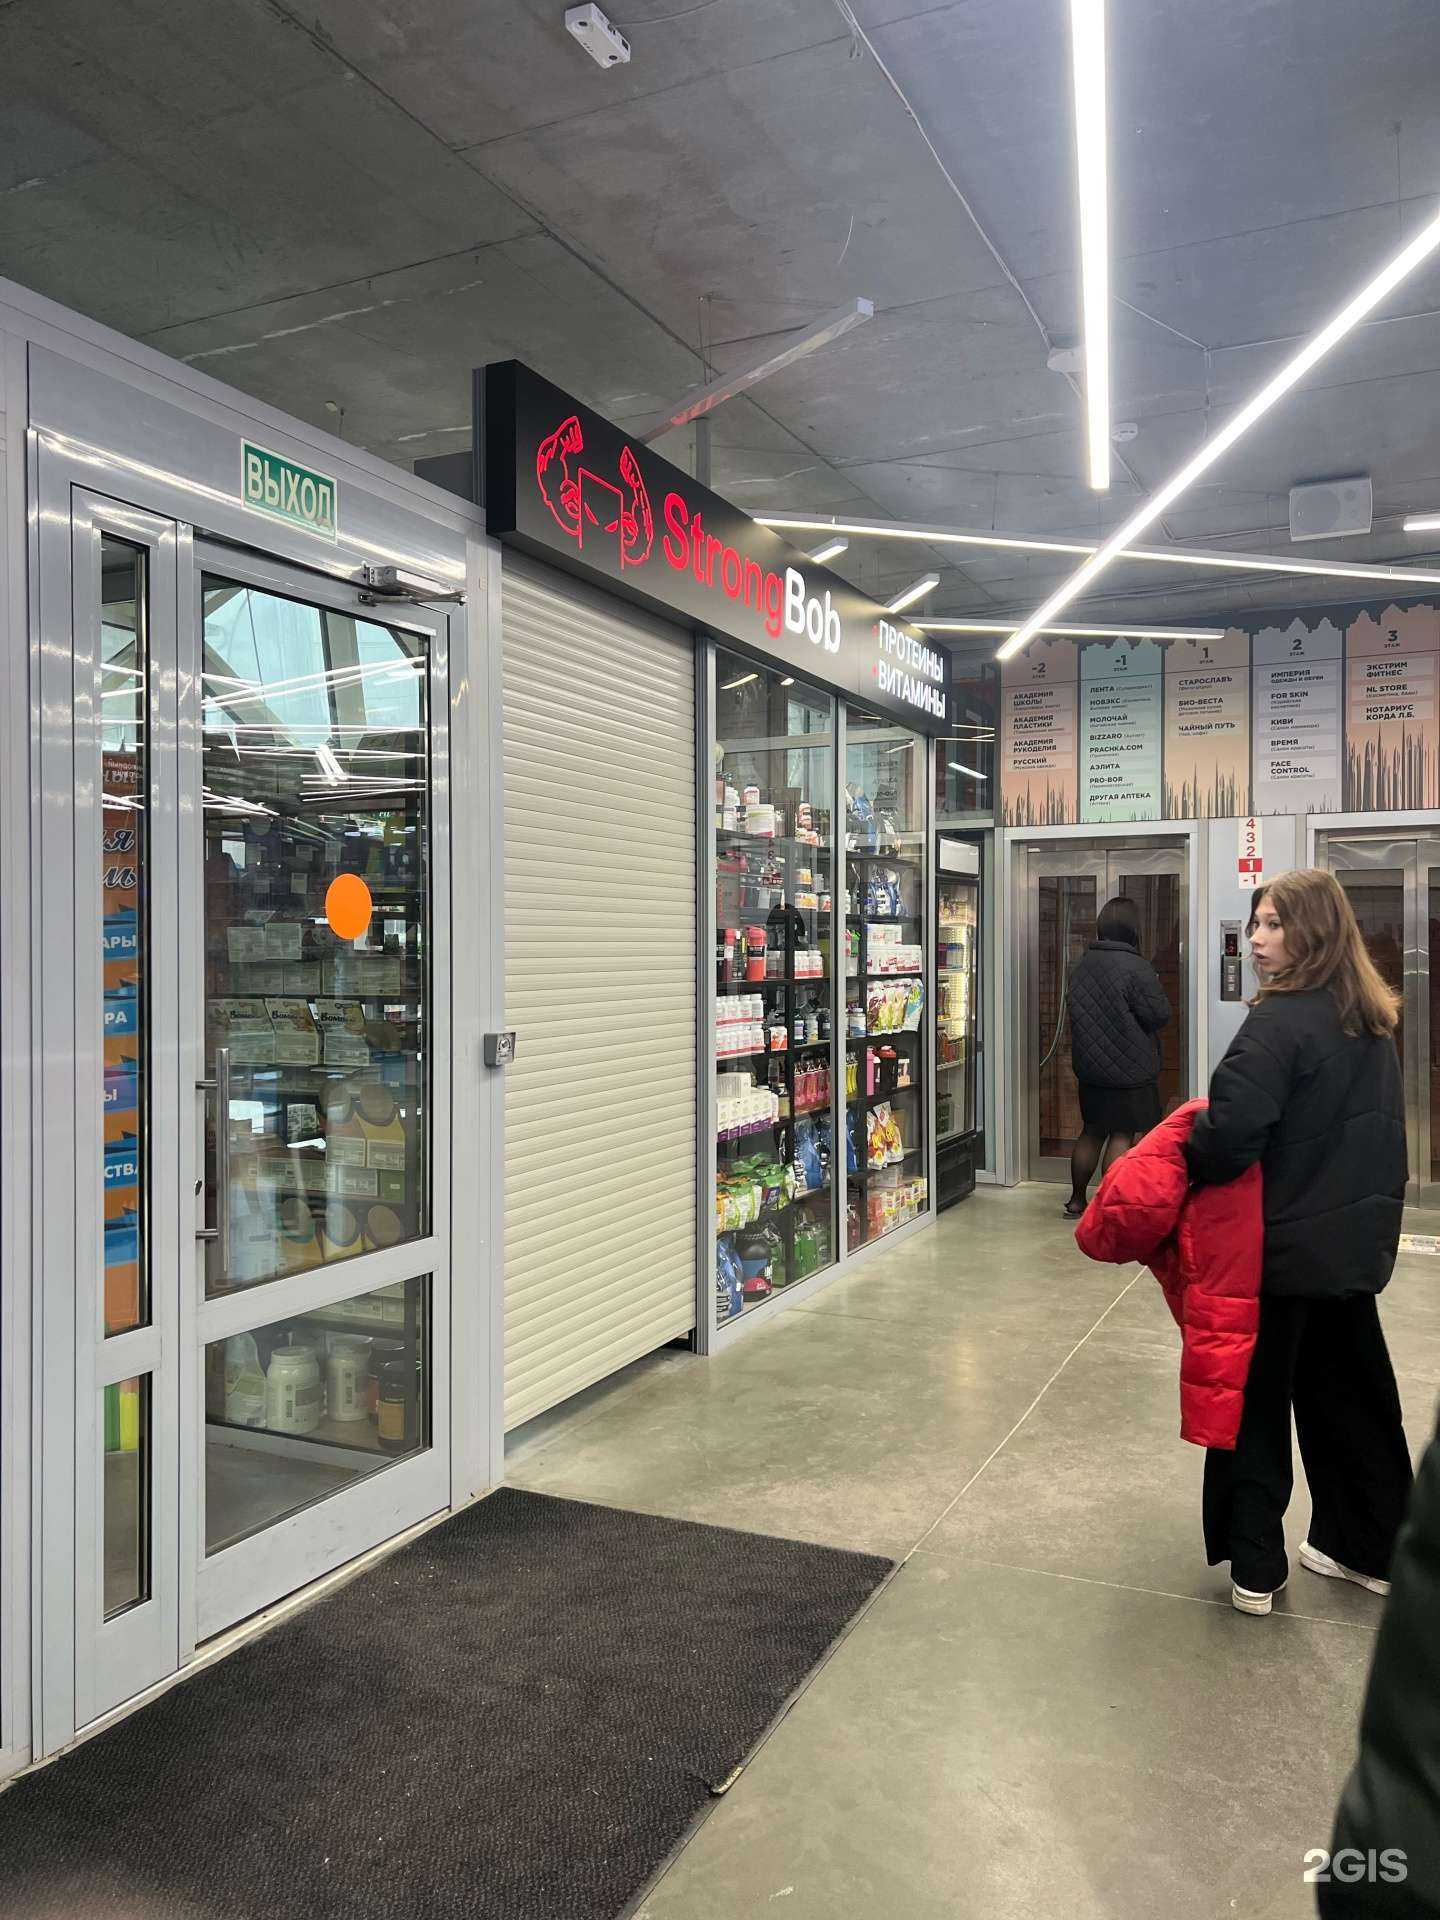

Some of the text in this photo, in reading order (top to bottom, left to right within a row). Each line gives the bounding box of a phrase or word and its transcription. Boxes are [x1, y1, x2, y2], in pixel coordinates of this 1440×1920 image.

[247, 452, 334, 529] ВЫХОД
[662, 492, 842, 655] StrongBob
[1388, 630, 1398, 641] 3
[1292, 639, 1302, 650] 2
[878, 619, 944, 684] ПРОТЕИНЫ
[1202, 647, 1209, 658] 1
[1115, 654, 1126, 666] -1
[1032, 662, 1046, 674] -2
[1367, 662, 1407, 670] ЭКСТРИМ
[1271, 670, 1310, 678] ИМПЕРИЯ
[1366, 670, 1402, 678] ФИТНЕС
[1178, 676, 1232, 686] СТАРОСЛАВЪ
[878, 659, 946, 719] ВИТАМИНЫ
[1013, 691, 1054, 700] АКАДЕМИЯ
[1178, 698, 1224, 706] БИО-ВЕСТА
[1366, 704, 1414, 713] НОТАРИУС
[1013, 715, 1054, 723] АКАДЕМИЯ
[1090, 713, 1128, 723] МОЛОЧАЙ
[1013, 722, 1052, 730] ПЛАСТИКИ
[1178, 722, 1213, 731] ЧАЙНЫЙ
[1013, 739, 1054, 747] АКАДЕМИЯ
[1013, 745, 1057, 753] РУКОДЕЛИЯ
[1090, 744, 1143, 753] PRACHKA.COM
[1246, 818, 1256, 828] 4
[1246, 832, 1255, 843] 3
[1246, 846, 1255, 856] 2
[1247, 860, 1254, 871] 1
[1243, 874, 1257, 884] -1
